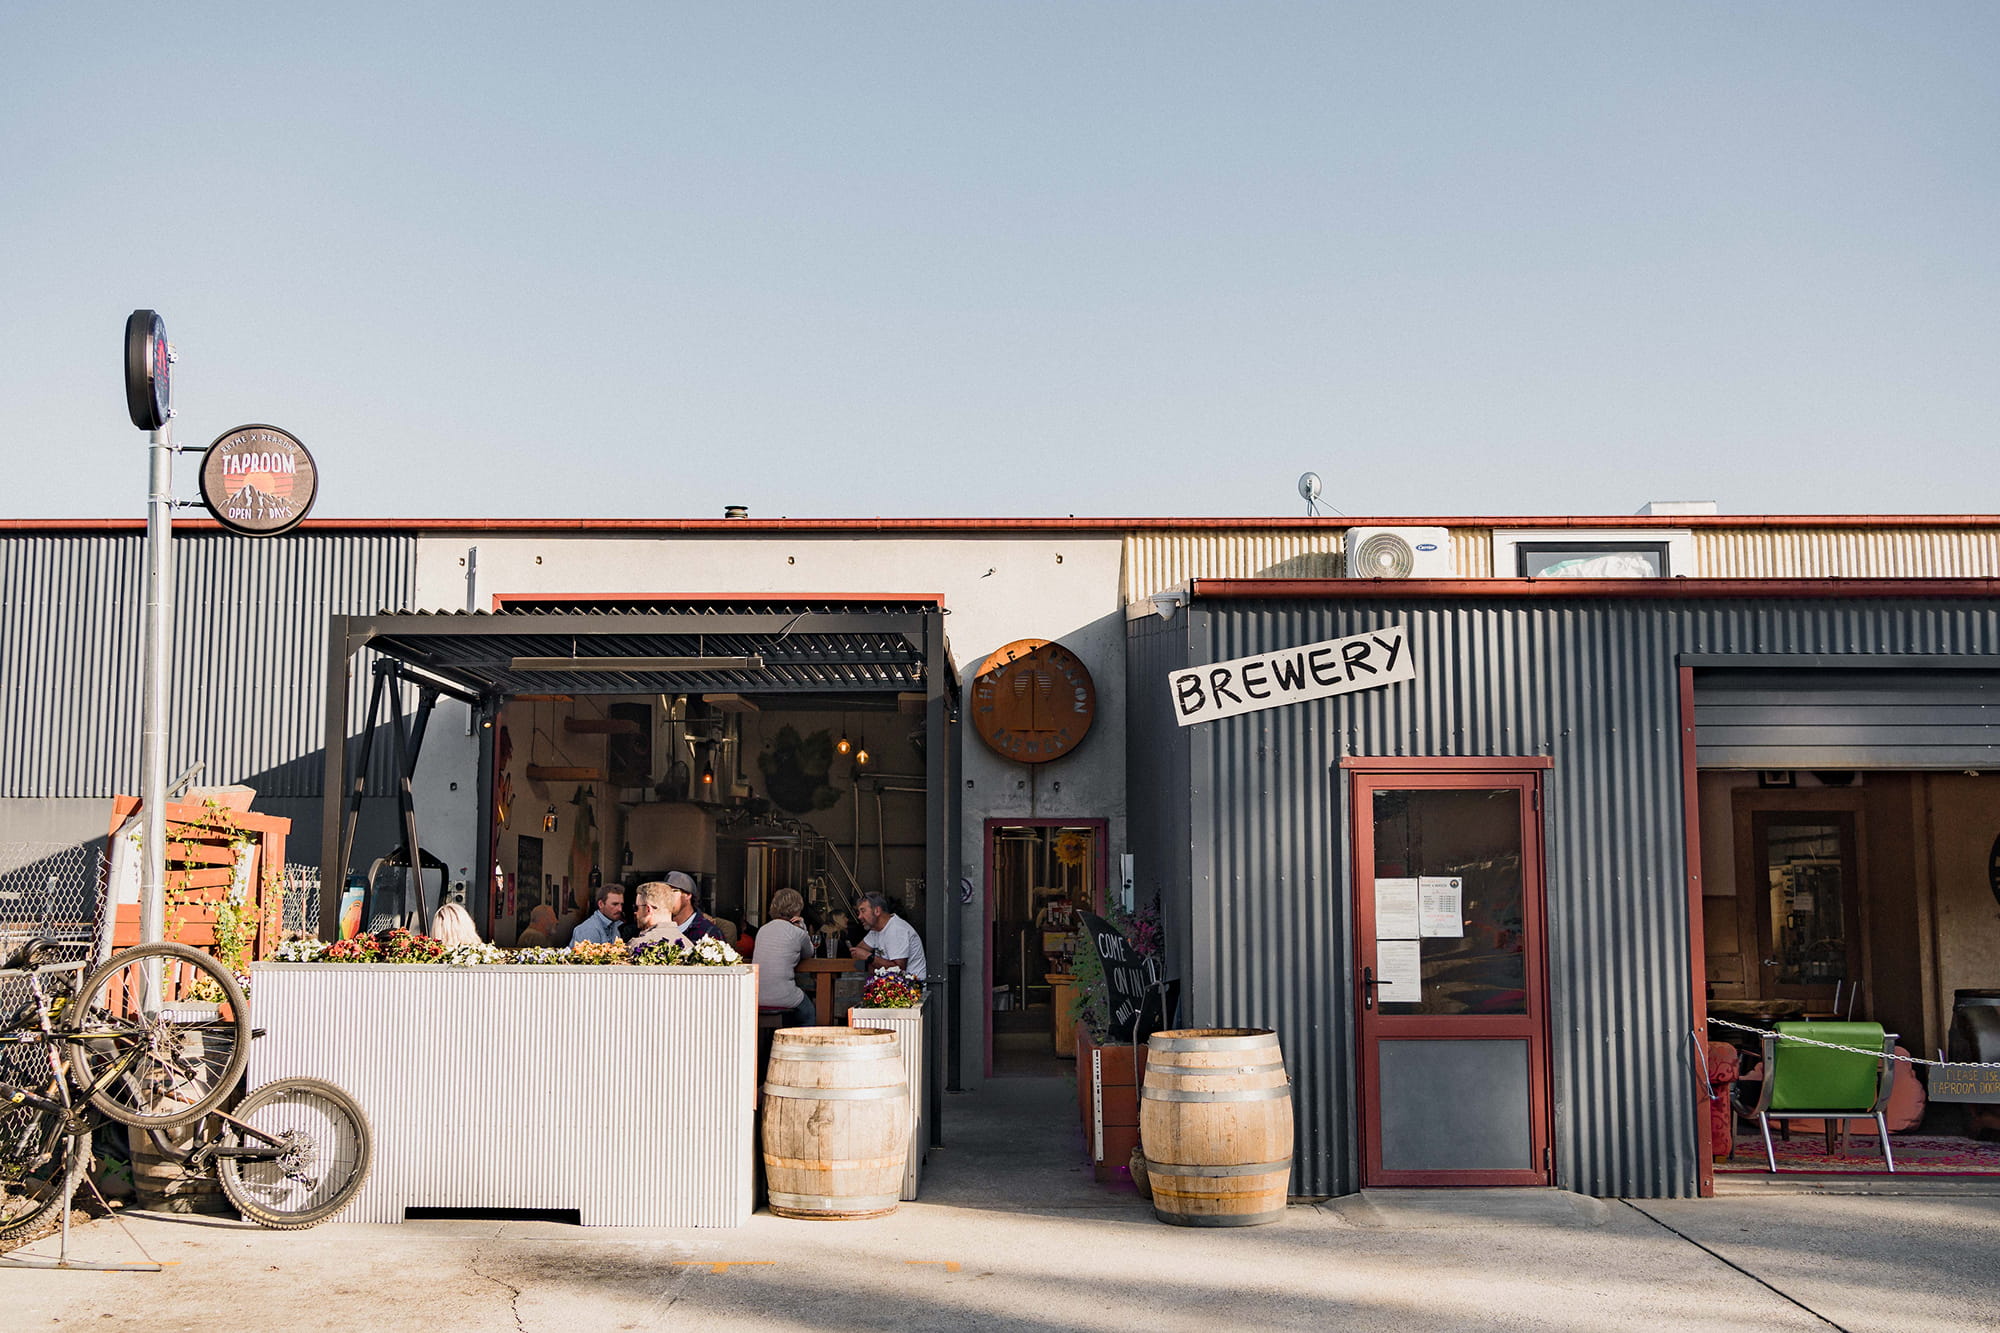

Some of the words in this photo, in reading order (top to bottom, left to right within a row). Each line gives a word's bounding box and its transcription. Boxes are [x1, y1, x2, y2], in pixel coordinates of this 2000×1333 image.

[221, 435, 247, 454] RHYME
[261, 434, 296, 452] REASON
[222, 452, 296, 475] TAPROOM
[228, 507, 252, 520] OPEN
[257, 508, 264, 520] 7
[269, 506, 293, 519] DAYS
[1176, 635, 1402, 717] BREWERY
[992, 727, 1073, 753] BREWERY
[1098, 932, 1127, 962] COME
[1113, 967, 1129, 995] ON
[1946, 1069, 1979, 1082] PLEASE
[1932, 1082, 1977, 1095] TAPROOM
